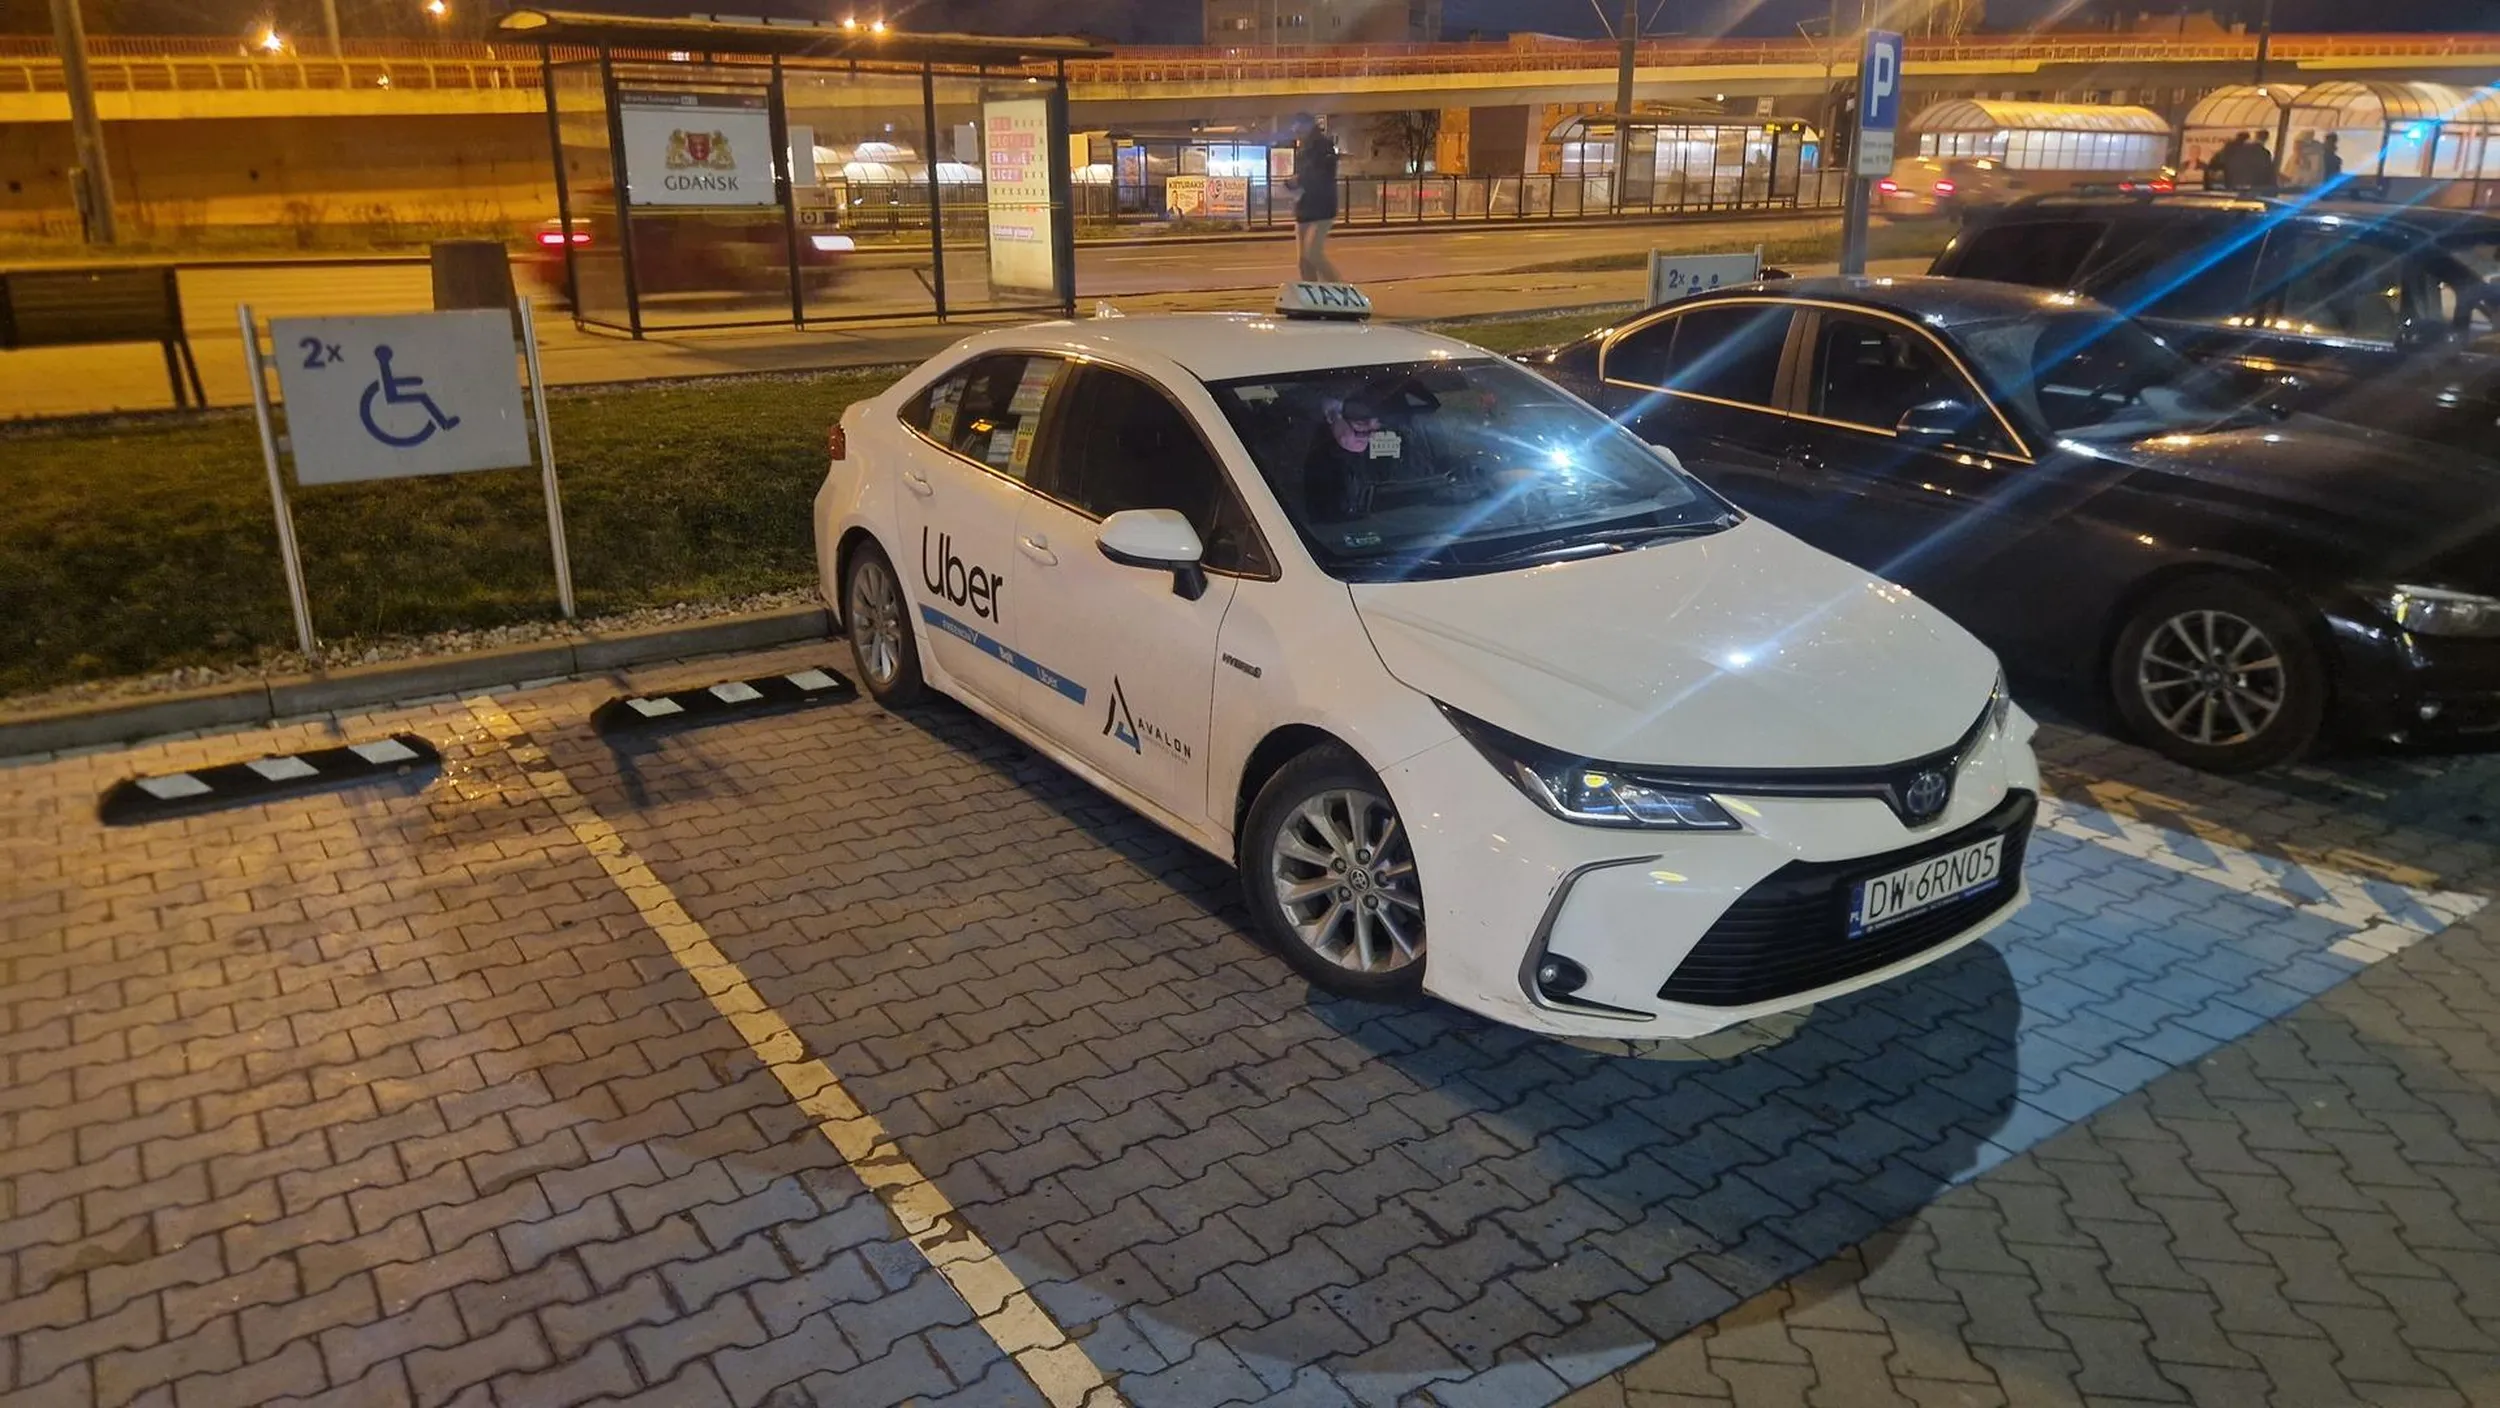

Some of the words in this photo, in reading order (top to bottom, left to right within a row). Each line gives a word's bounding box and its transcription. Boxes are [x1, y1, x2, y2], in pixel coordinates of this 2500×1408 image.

[1871, 42, 1894, 116] P
[664, 172, 739, 191] GDAŃSK
[1298, 284, 1365, 307] TAXI
[1669, 269, 1685, 288] 2x
[299, 336, 344, 370] 2x
[922, 525, 1003, 624] Uber
[1137, 717, 1191, 759] AVALON
[1869, 873, 1907, 920] DW
[1916, 841, 1997, 901] 6RN05
